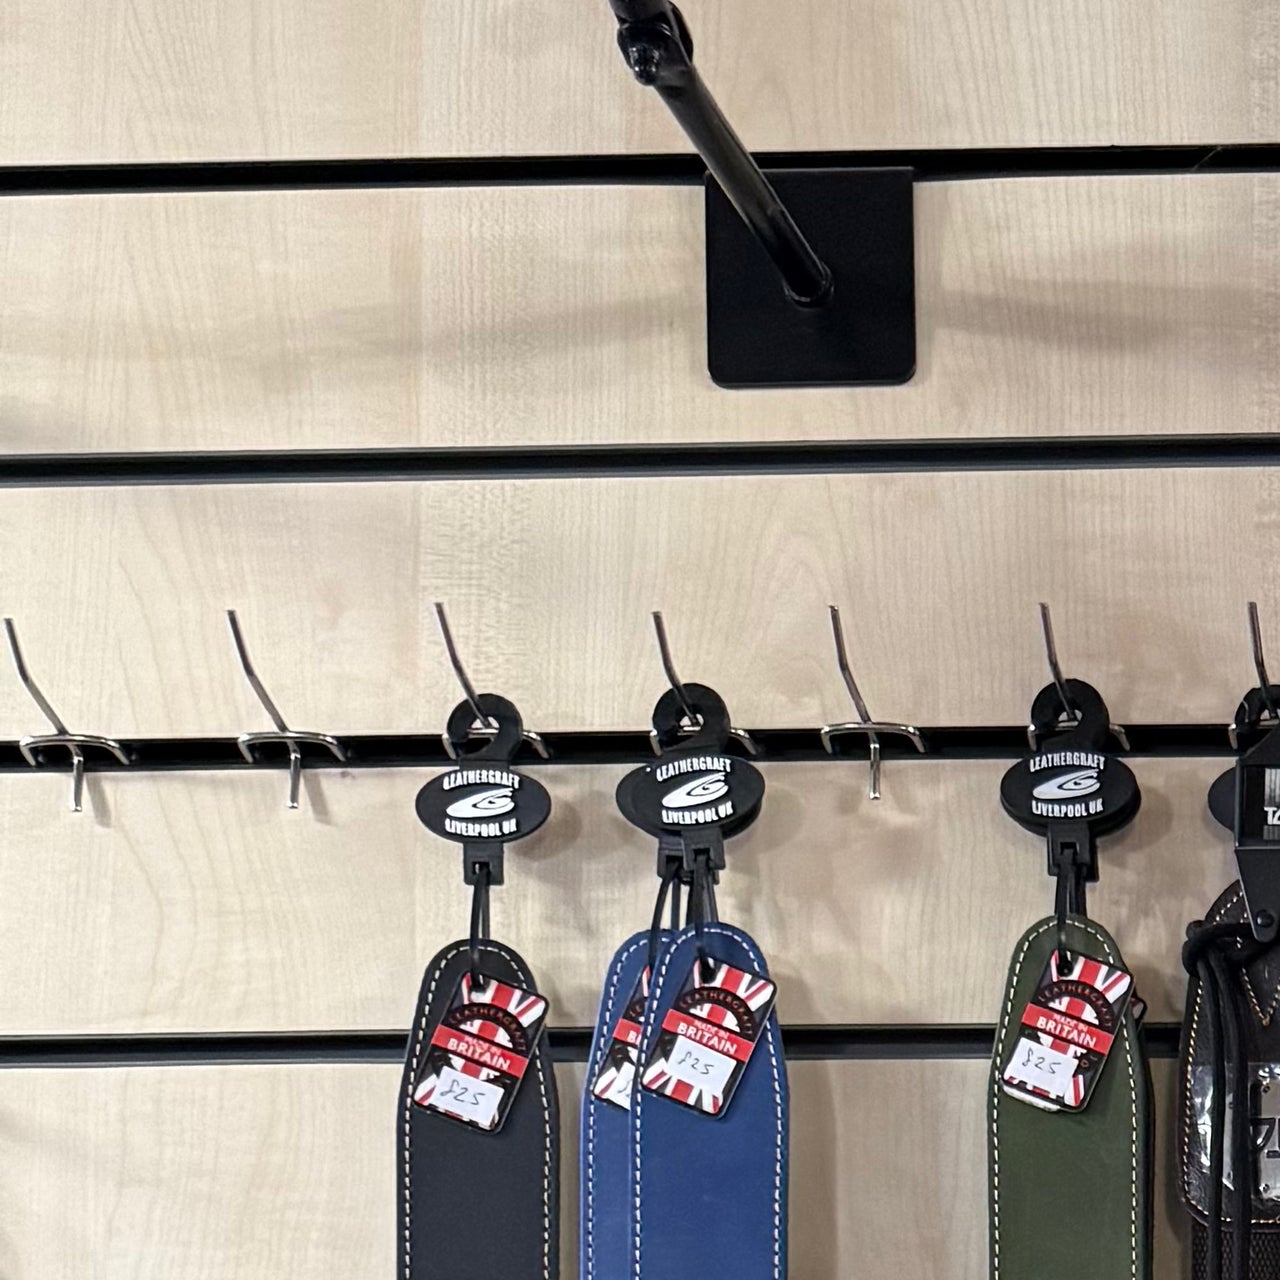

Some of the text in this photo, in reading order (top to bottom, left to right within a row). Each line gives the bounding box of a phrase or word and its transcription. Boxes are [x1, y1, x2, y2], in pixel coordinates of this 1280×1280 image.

[1029, 751, 1105, 773] LEATHERGRAFT
[661, 800, 733, 825] LIVERPOOL UK
[1031, 798, 1104, 818] LIVERPOOL UK
[445, 818, 517, 837] LIVERPOOL UK
[677, 1021, 738, 1056] BRITAIN
[1035, 1017, 1097, 1049] BRITAIN
[446, 1038, 511, 1070] BRITAIN
[677, 1050, 715, 1077] £25
[440, 1078, 487, 1106] £25
